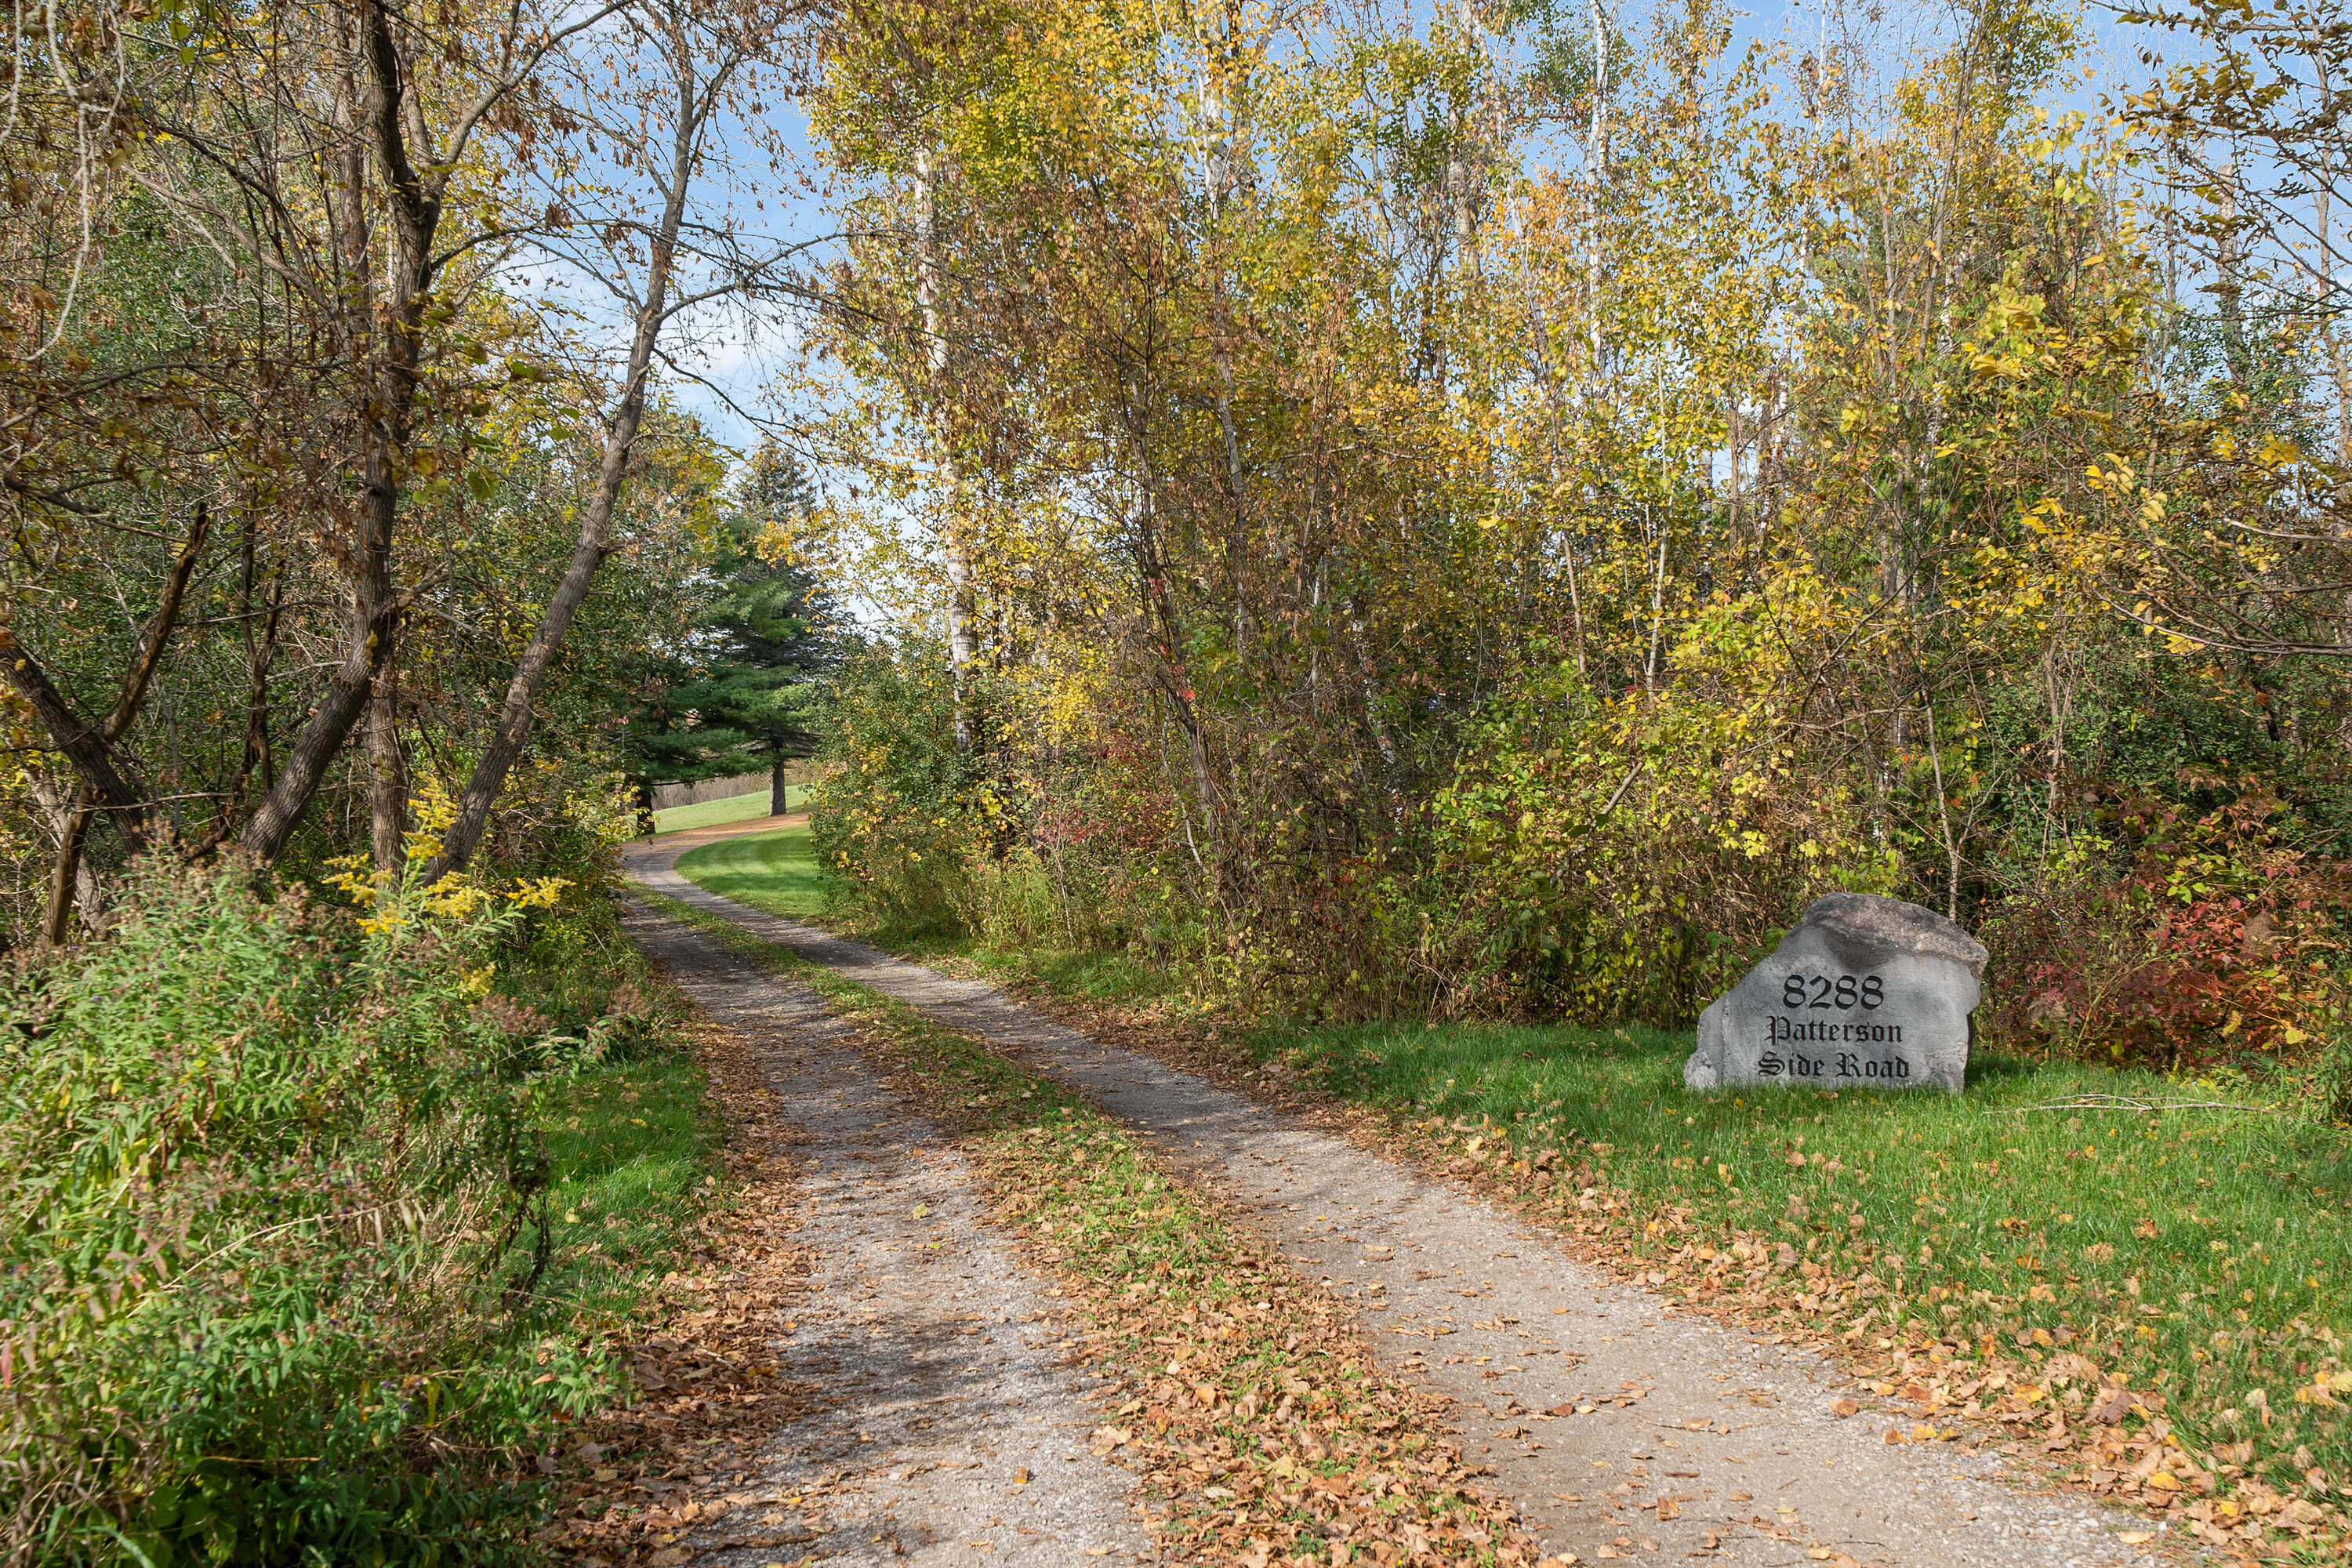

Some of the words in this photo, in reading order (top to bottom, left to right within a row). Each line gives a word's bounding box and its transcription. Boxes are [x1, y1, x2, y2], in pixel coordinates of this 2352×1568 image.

[1783, 975, 1884, 1010] 8288
[1764, 1015, 1903, 1046] Patterson
[1758, 1051, 1825, 1077] Side
[1835, 1052, 1909, 1078] Road
